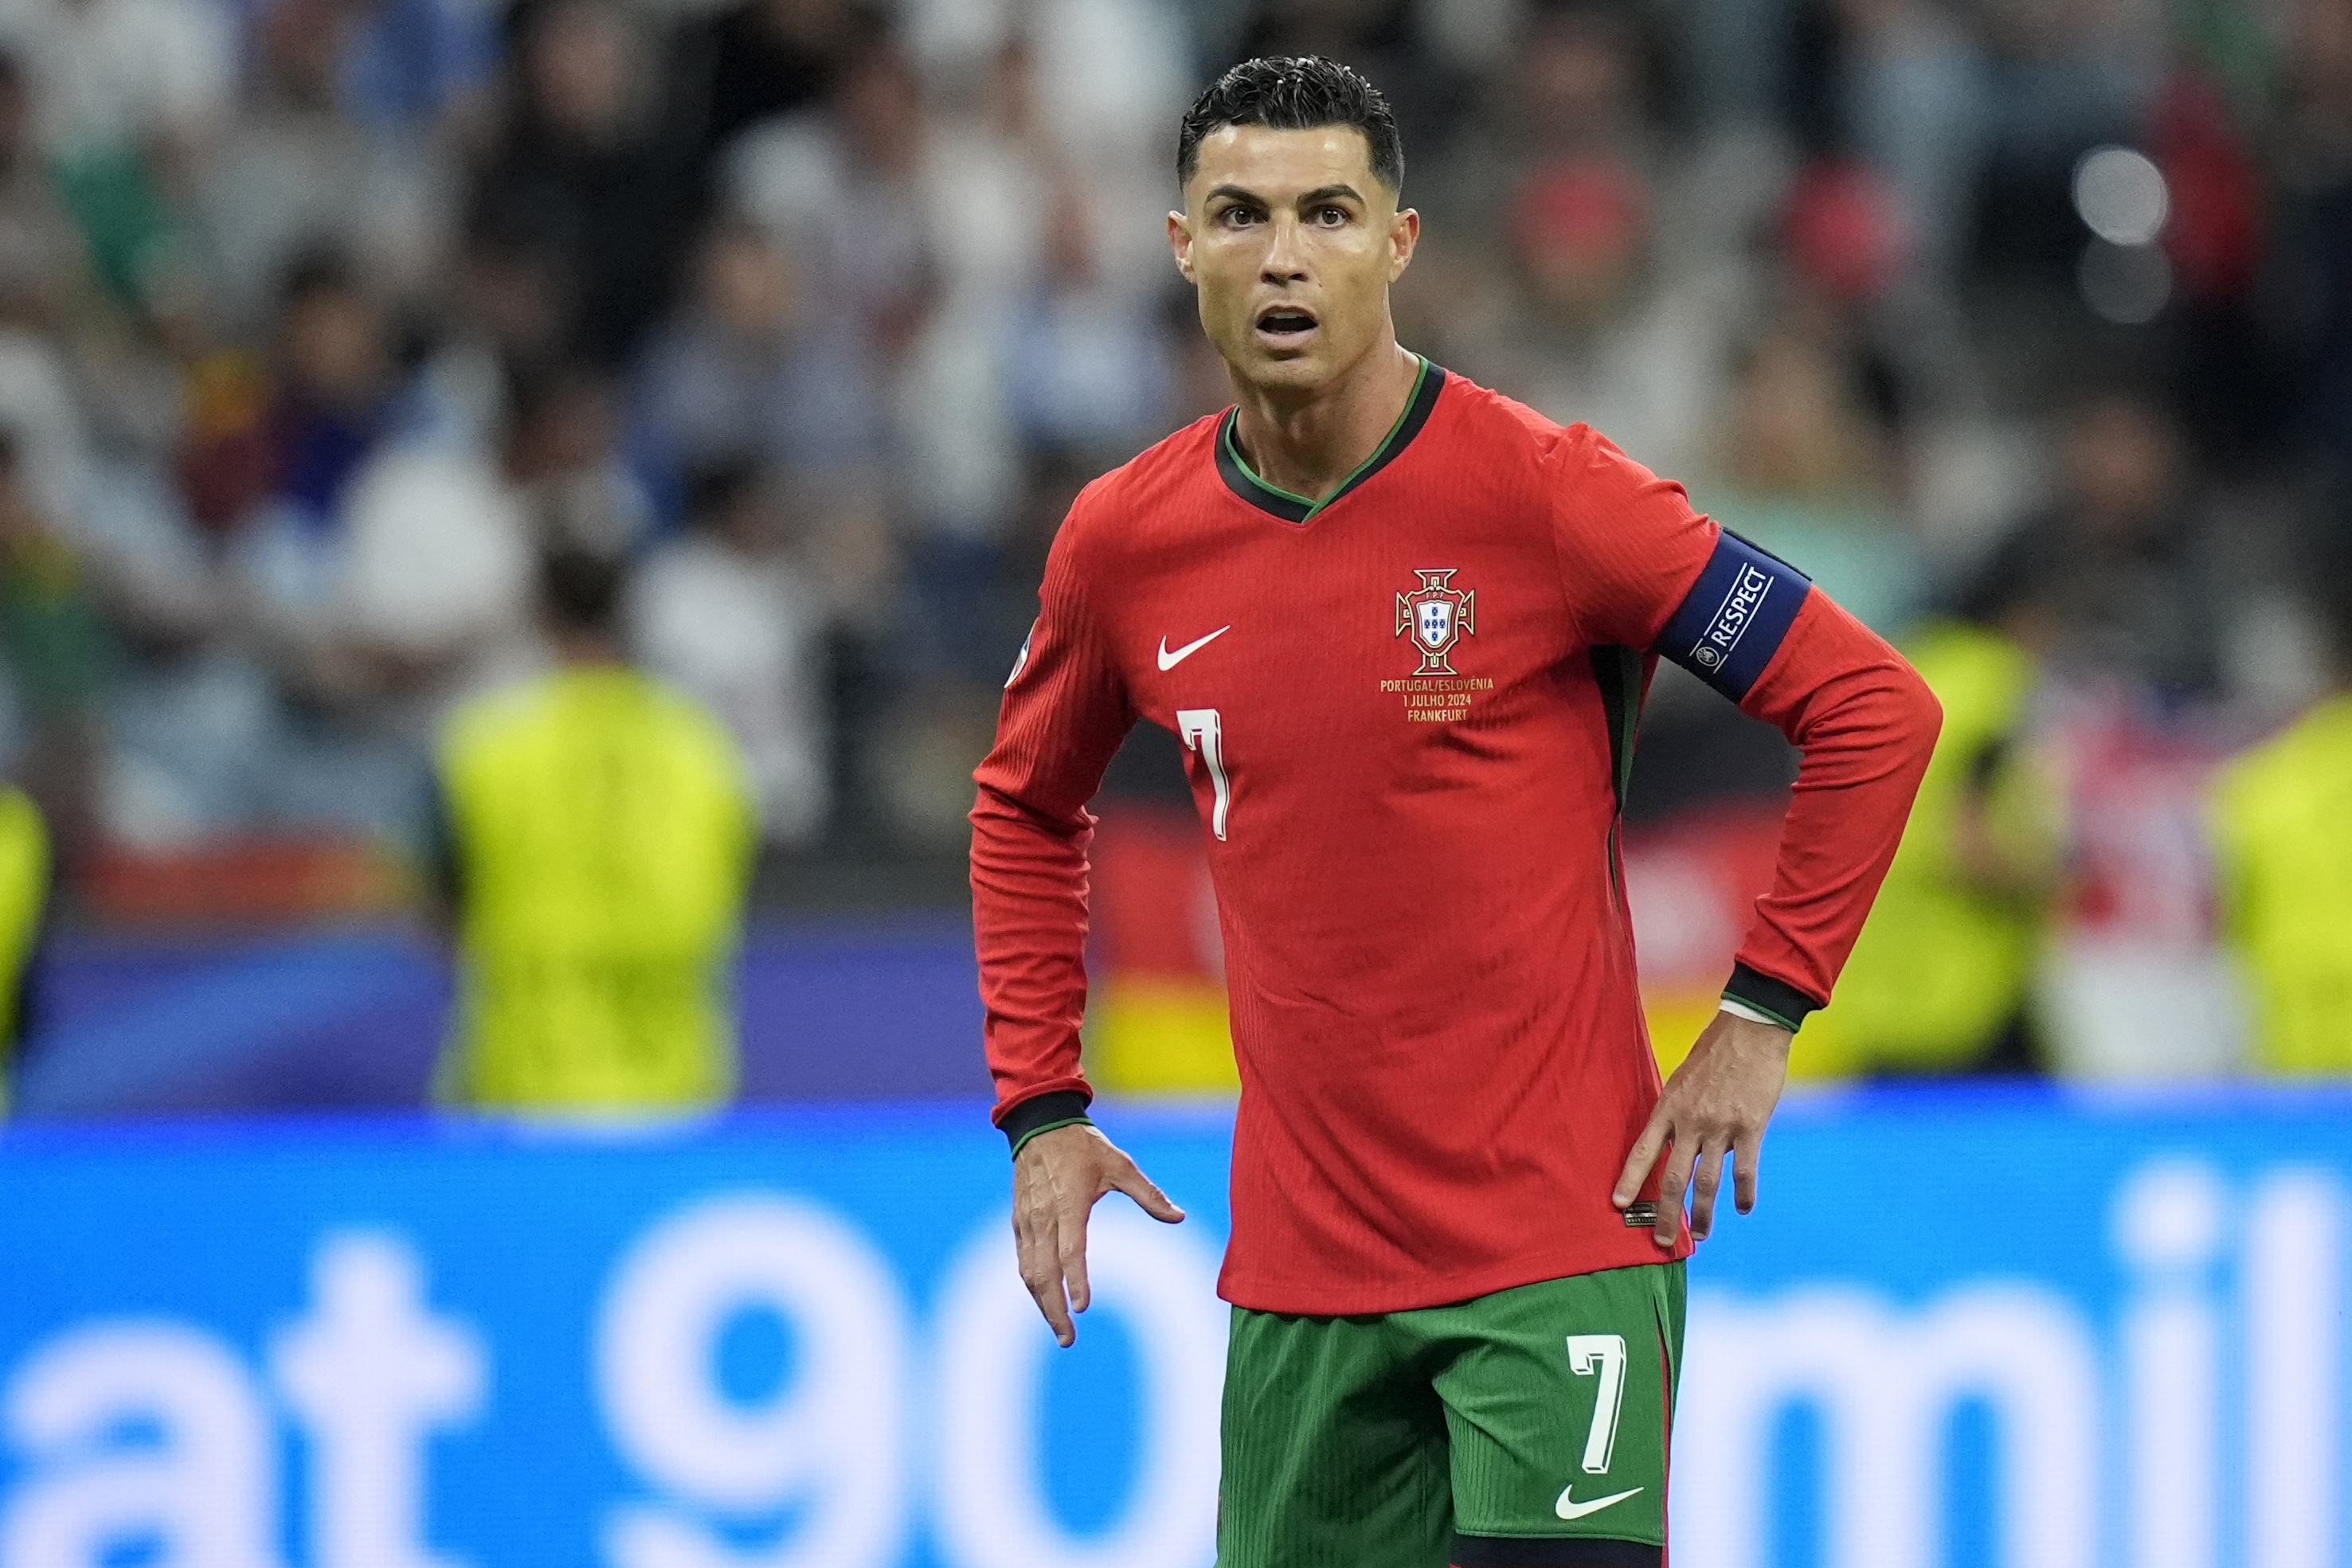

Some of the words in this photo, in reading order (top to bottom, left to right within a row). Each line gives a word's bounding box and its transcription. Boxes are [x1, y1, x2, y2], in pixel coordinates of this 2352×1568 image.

[1710, 565, 1767, 647] RESPECT
[1380, 676, 1494, 692] PORTUGAL/ESLOVÉNIA
[1403, 694, 1407, 707] 1
[1411, 694, 1445, 707] JULHO
[1447, 694, 1471, 706] 2024
[1407, 709, 1468, 722] FRANKFURT
[1176, 708, 1230, 842] 7
[4, 1230, 484, 1568] at
[596, 1195, 1220, 1568] 90
[1566, 1335, 1627, 1475] 7
